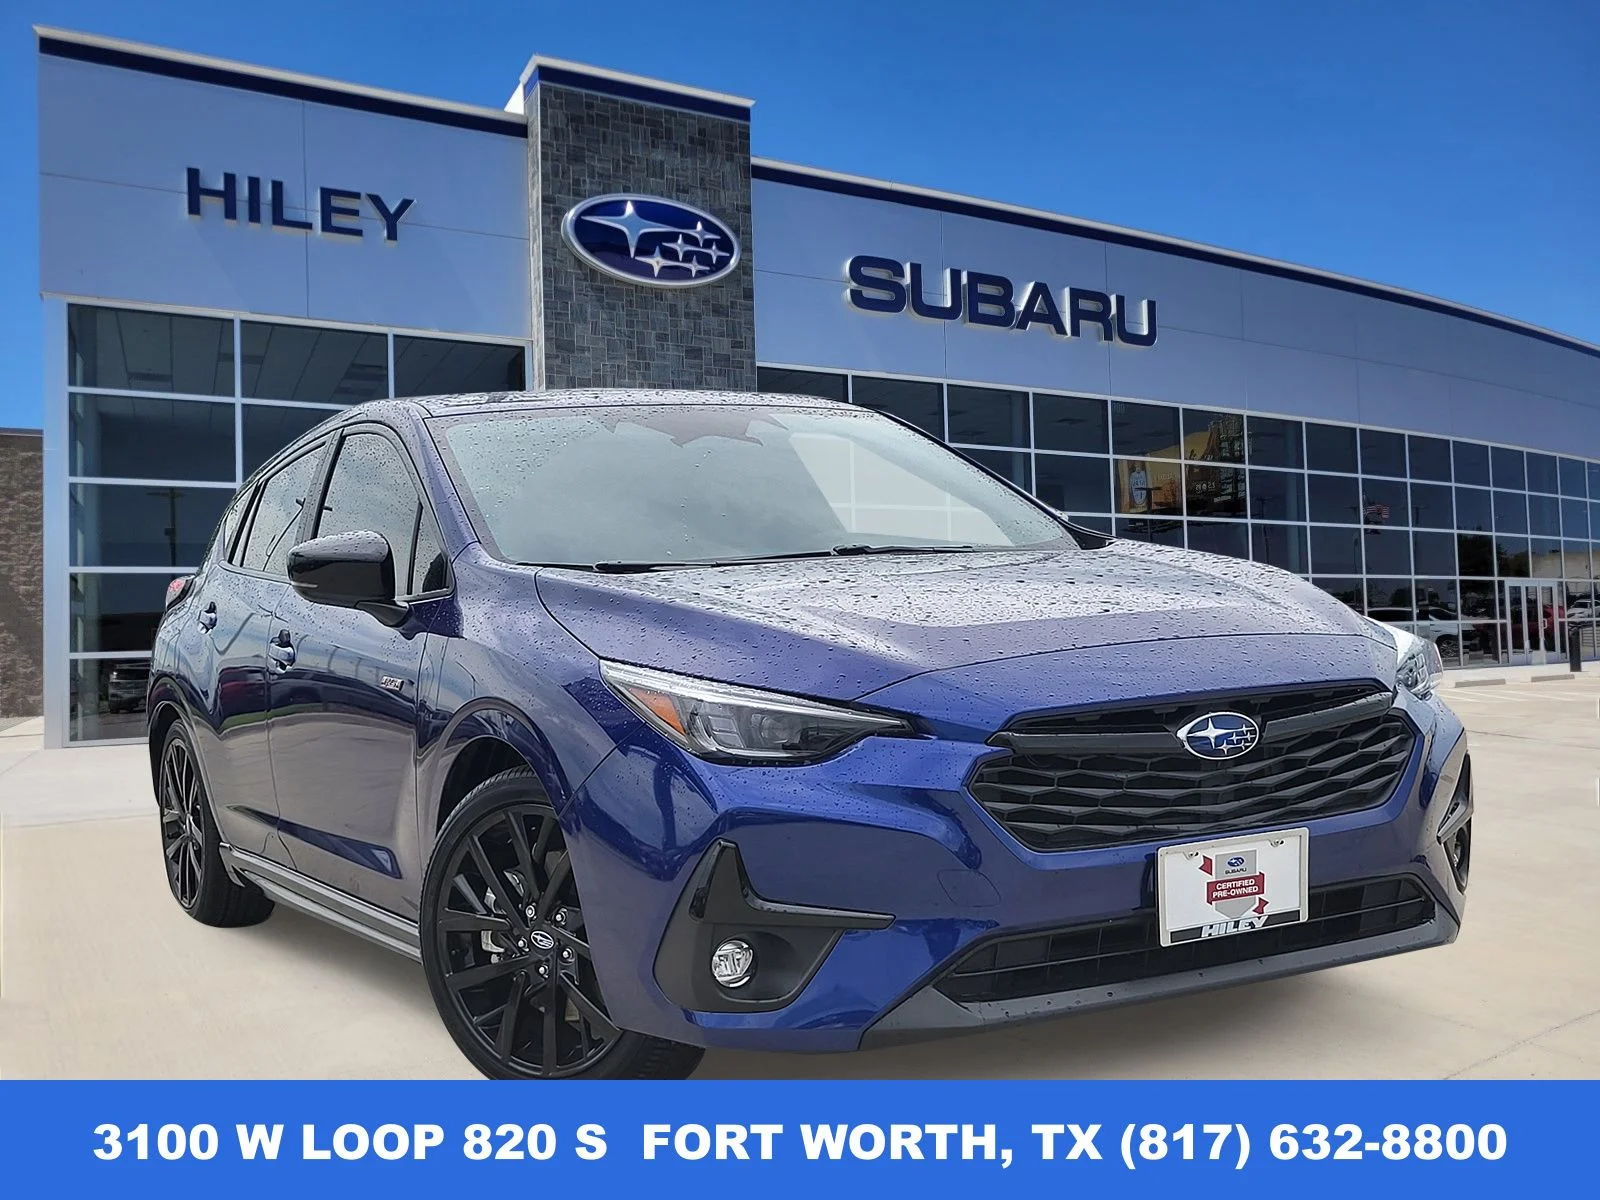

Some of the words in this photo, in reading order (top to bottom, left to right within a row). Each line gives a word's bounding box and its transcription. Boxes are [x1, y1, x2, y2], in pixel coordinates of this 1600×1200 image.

[186, 167, 416, 241] HILEY
[846, 254, 1158, 347] SUBARU
[1225, 867, 1247, 875] SUBARU
[1212, 886, 1258, 899] PRE-OWNED
[1216, 878, 1255, 890] CERTIFIED
[1202, 915, 1269, 937] HILEY
